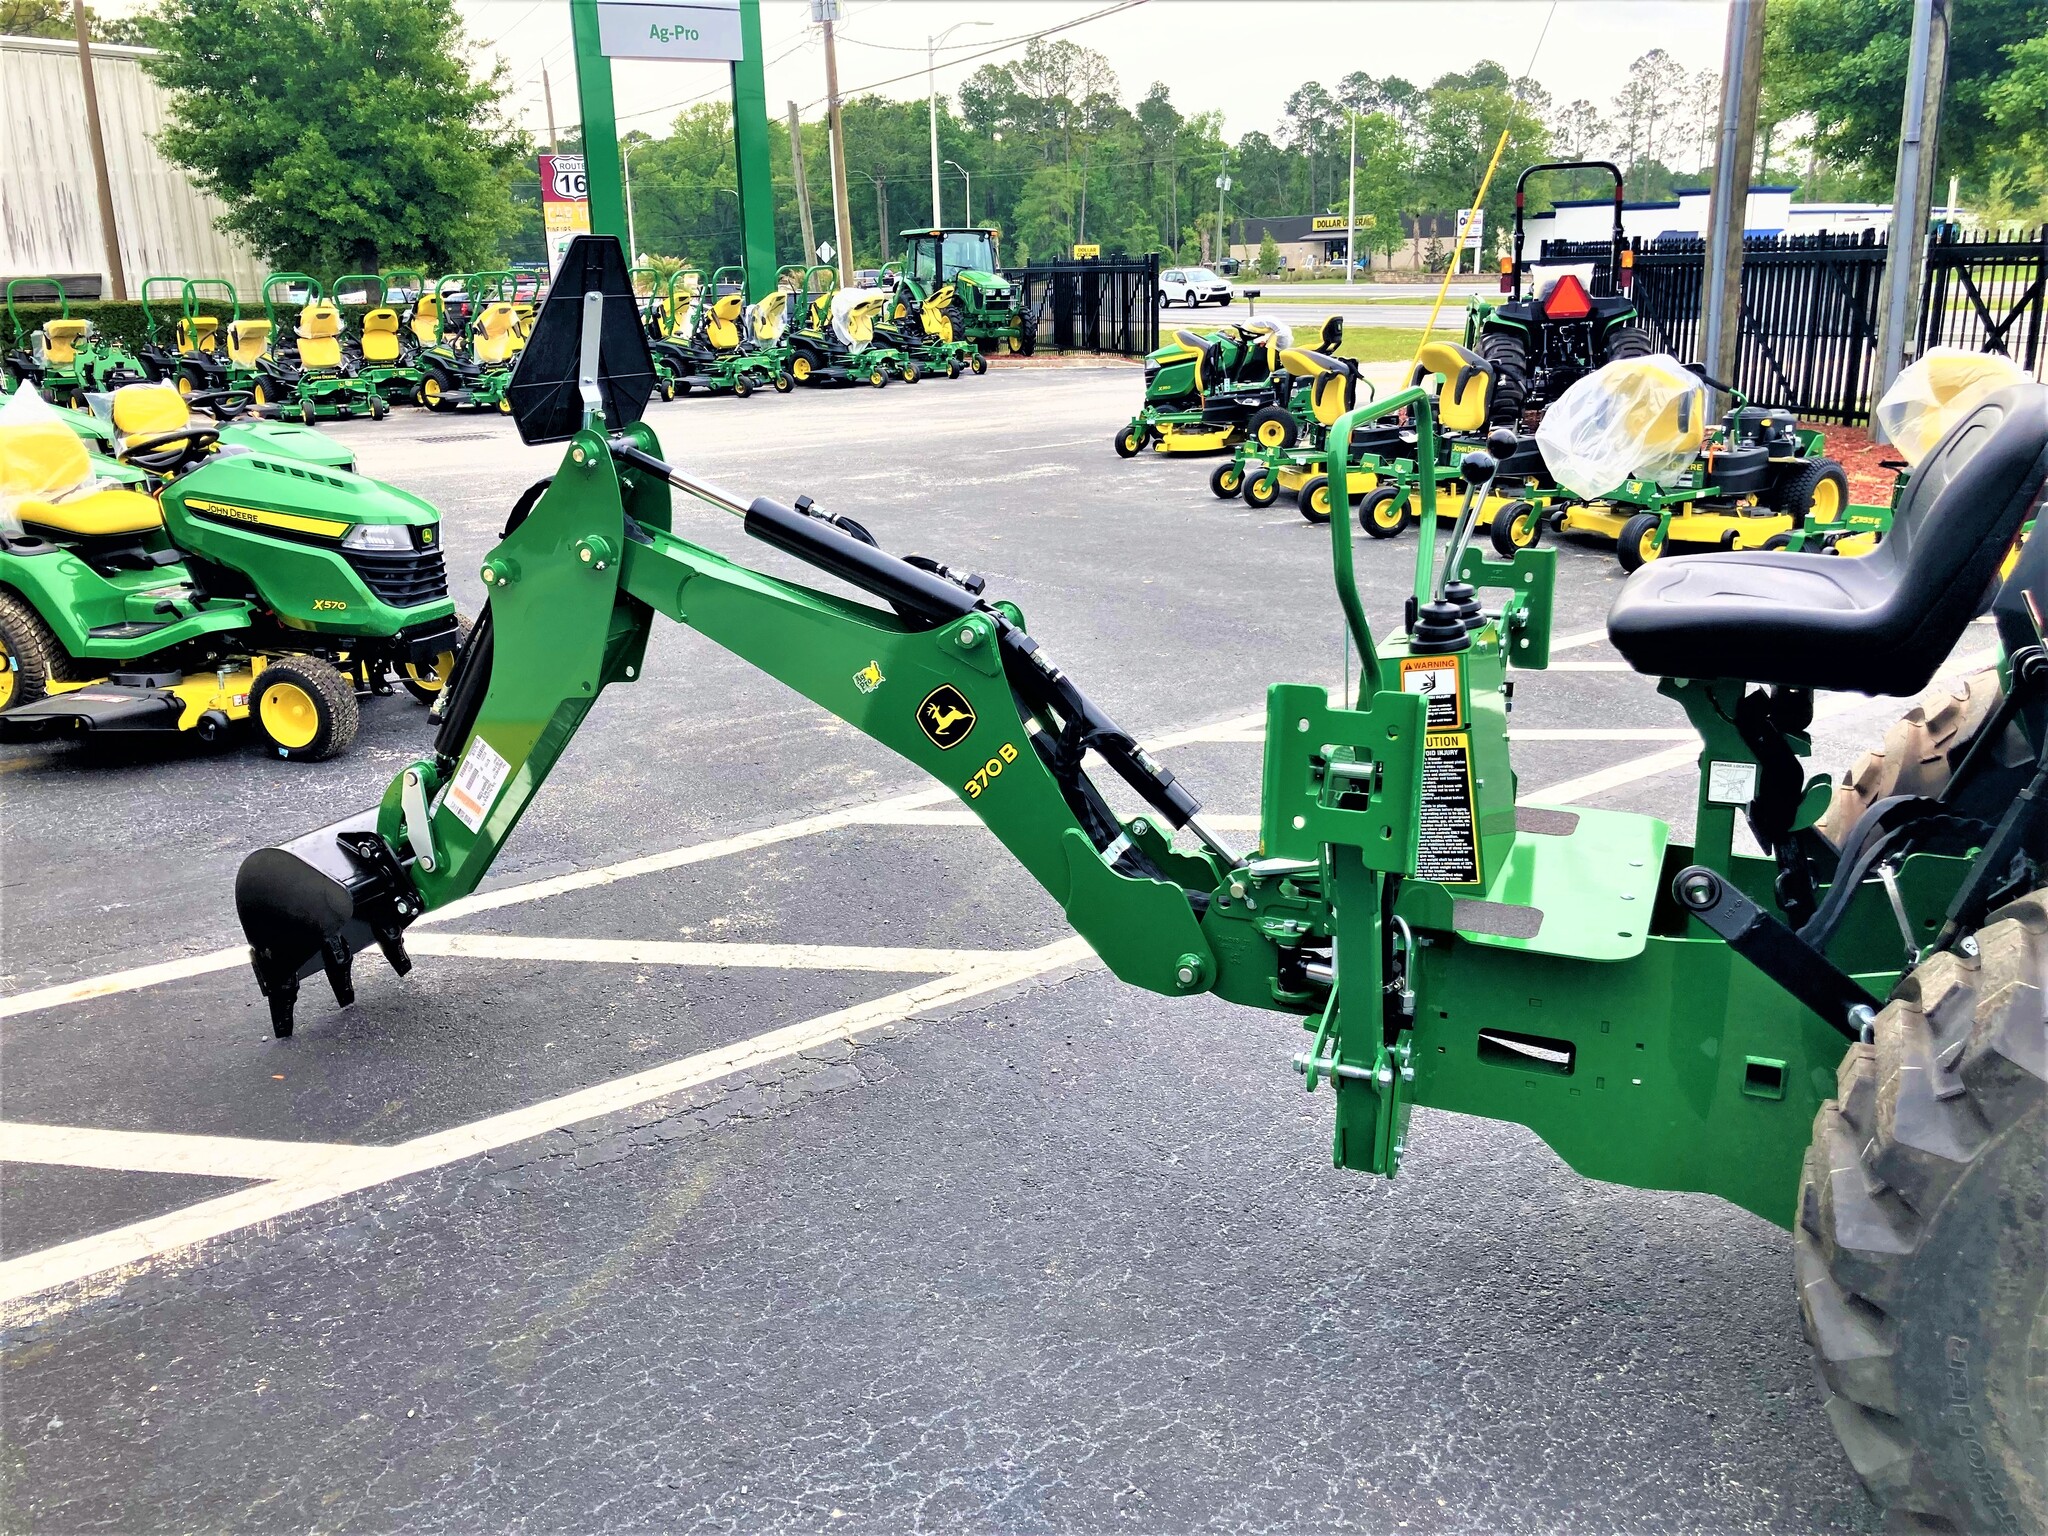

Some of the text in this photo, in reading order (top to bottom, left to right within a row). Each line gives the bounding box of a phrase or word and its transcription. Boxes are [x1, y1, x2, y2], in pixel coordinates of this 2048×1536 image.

[649, 24, 699, 43] Ag-Pro
[560, 162, 585, 170] ROUTE
[559, 174, 587, 193] 16
[1317, 219, 1342, 228] DOLLAR
[205, 503, 259, 523] JOHN DEERE
[312, 599, 347, 611] X570
[1413, 659, 1455, 670] WARNING
[963, 741, 1019, 800] 370 B
